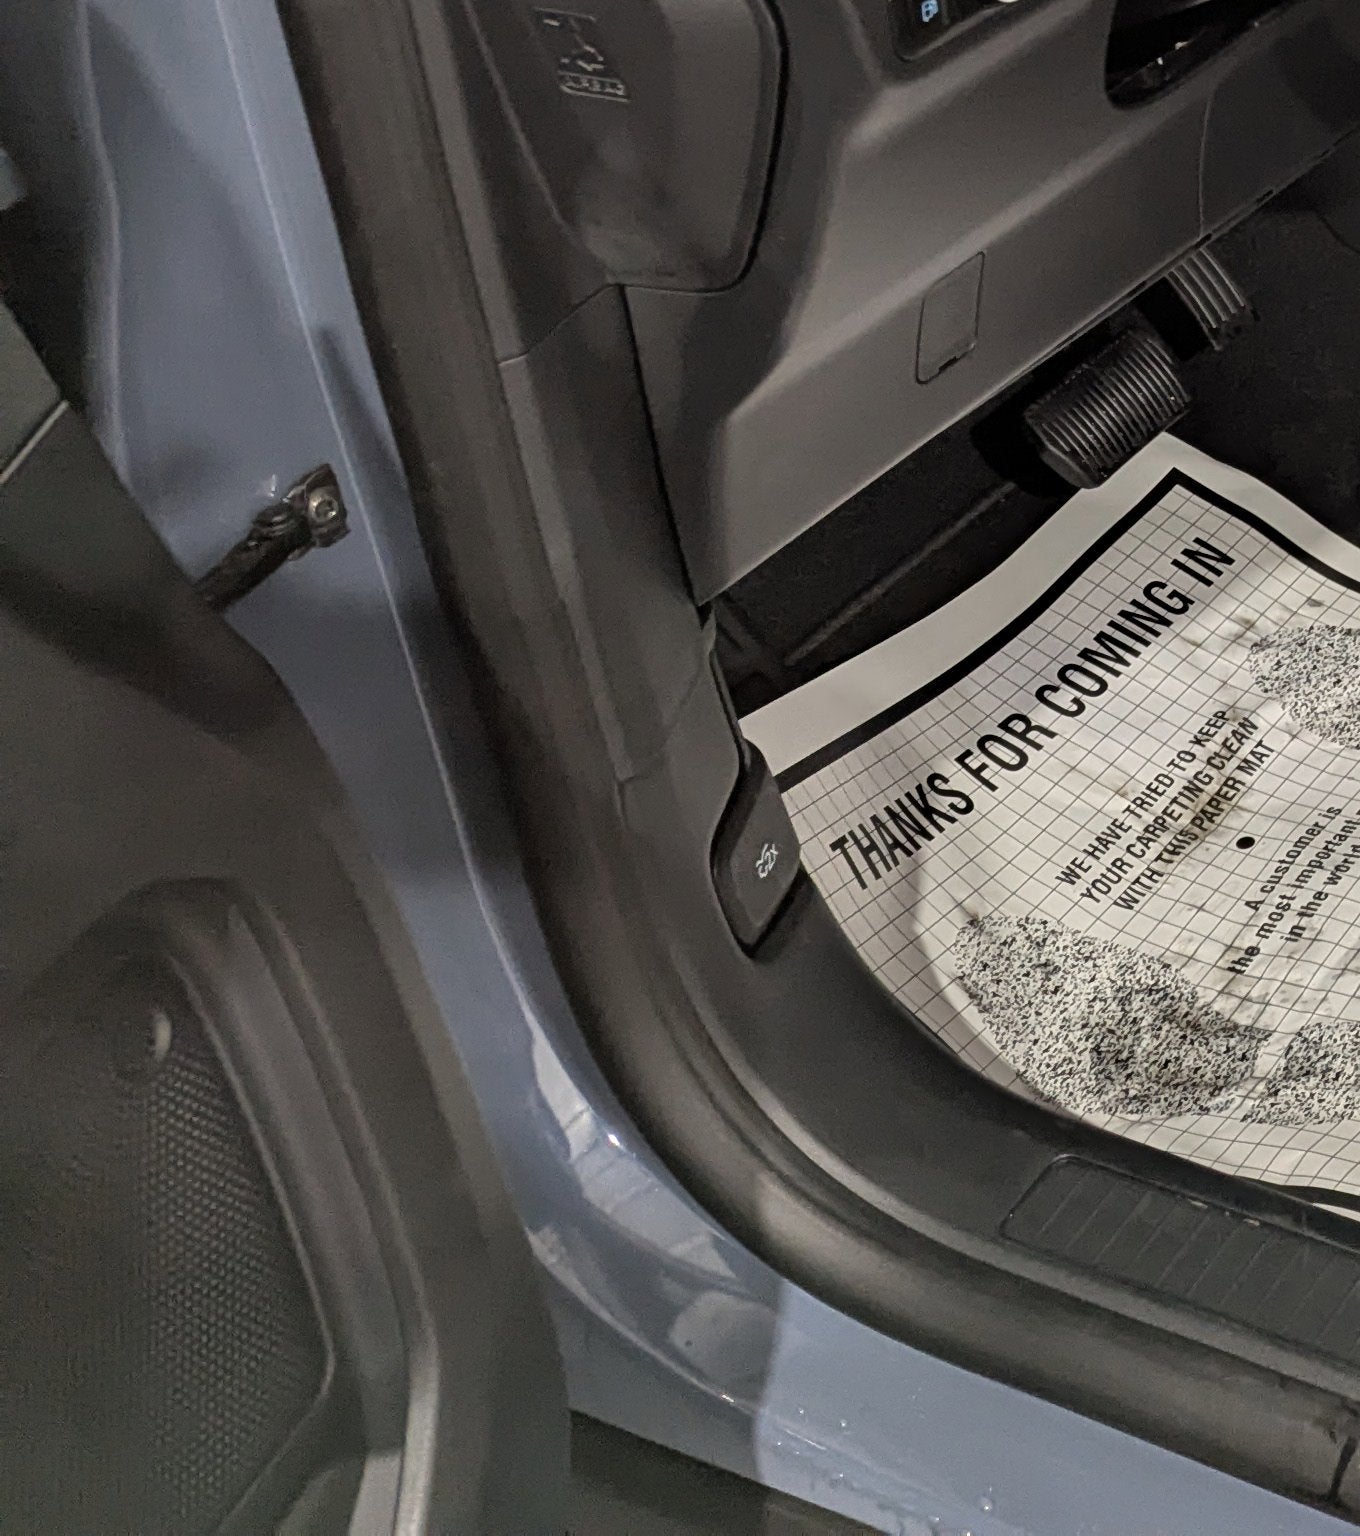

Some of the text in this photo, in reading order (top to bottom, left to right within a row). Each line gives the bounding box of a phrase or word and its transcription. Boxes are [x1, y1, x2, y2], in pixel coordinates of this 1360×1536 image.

[830, 536, 1236, 890] THANKS FOR COMING IN
[1055, 710, 1230, 886] WE HAVE TRIED TO KEEP
[1080, 716, 1259, 904] YOUR CARPETING CLEAN
[1113, 739, 1275, 911] WITH THIS PAPER MAT
[1244, 806, 1343, 912] A customer is
[1227, 945, 1261, 975] the
[1256, 894, 1297, 940] most
[1279, 924, 1307, 943] in
[1297, 890, 1329, 919] the
